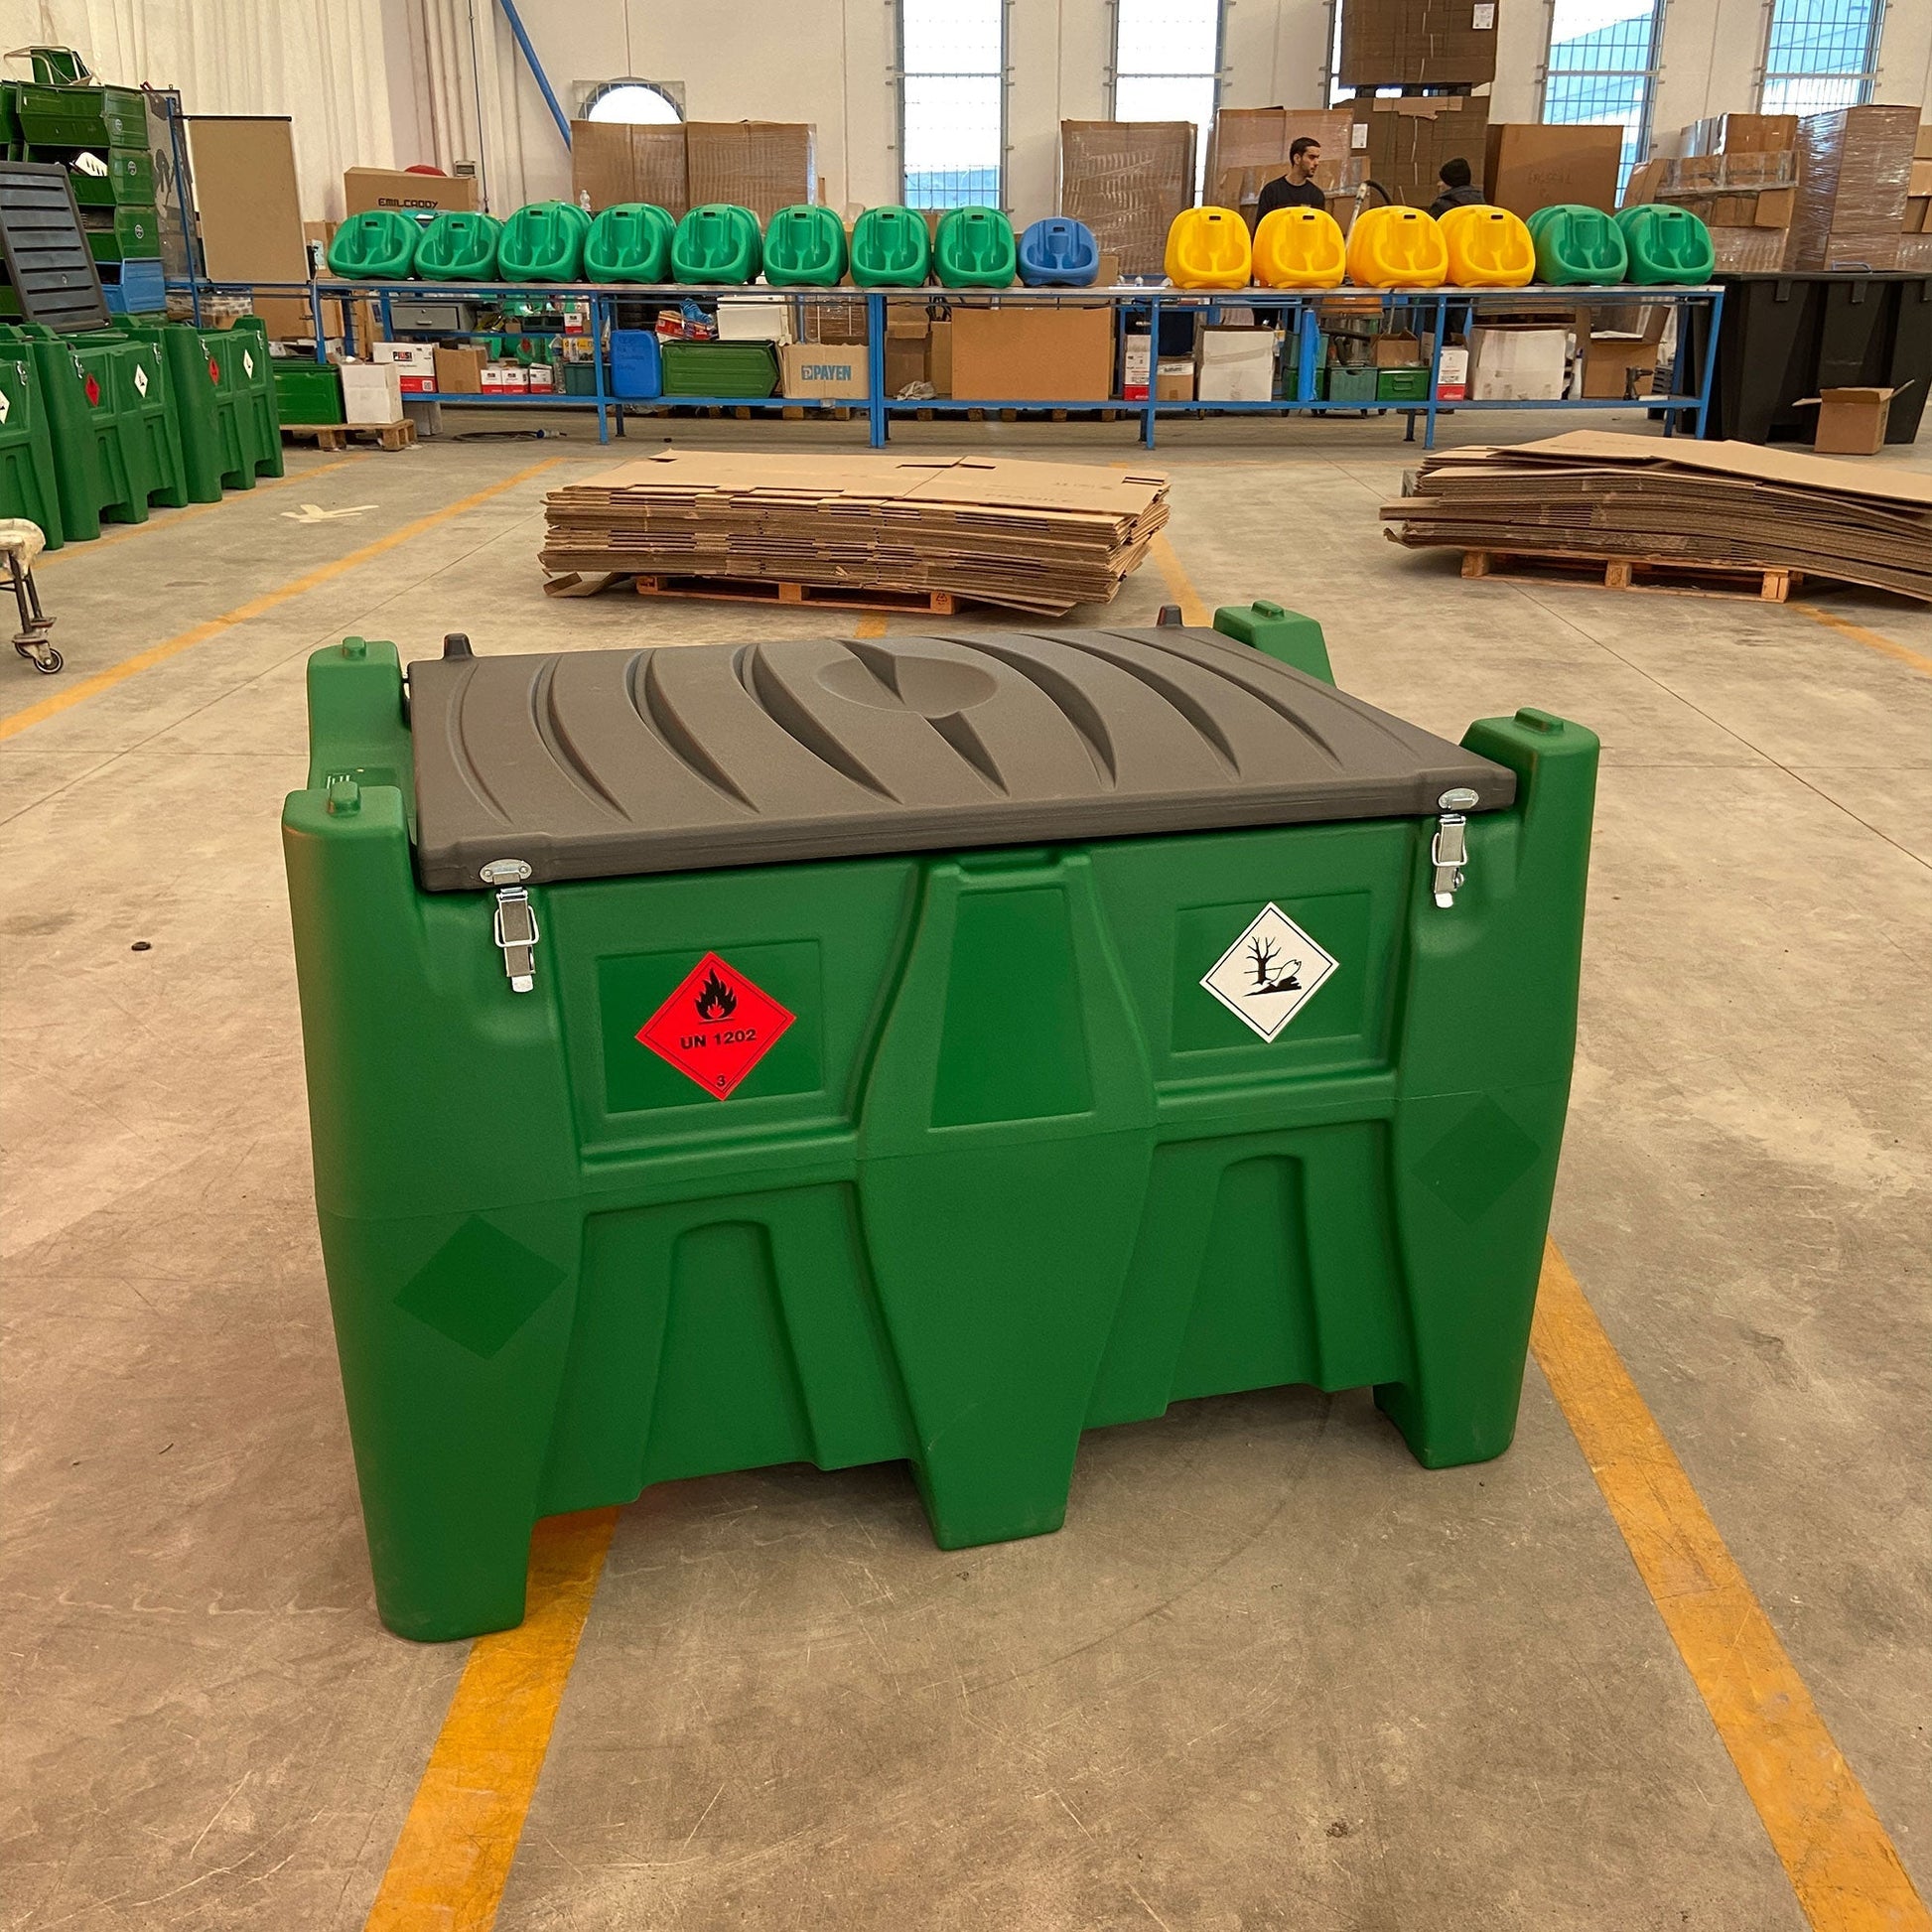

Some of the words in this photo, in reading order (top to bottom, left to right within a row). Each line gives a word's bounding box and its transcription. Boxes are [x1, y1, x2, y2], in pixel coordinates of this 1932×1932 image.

[814, 365, 851, 380] PAYEN
[680, 1035, 706, 1049] UN
[714, 1029, 757, 1045] 1202
[717, 1075, 726, 1086] 3
